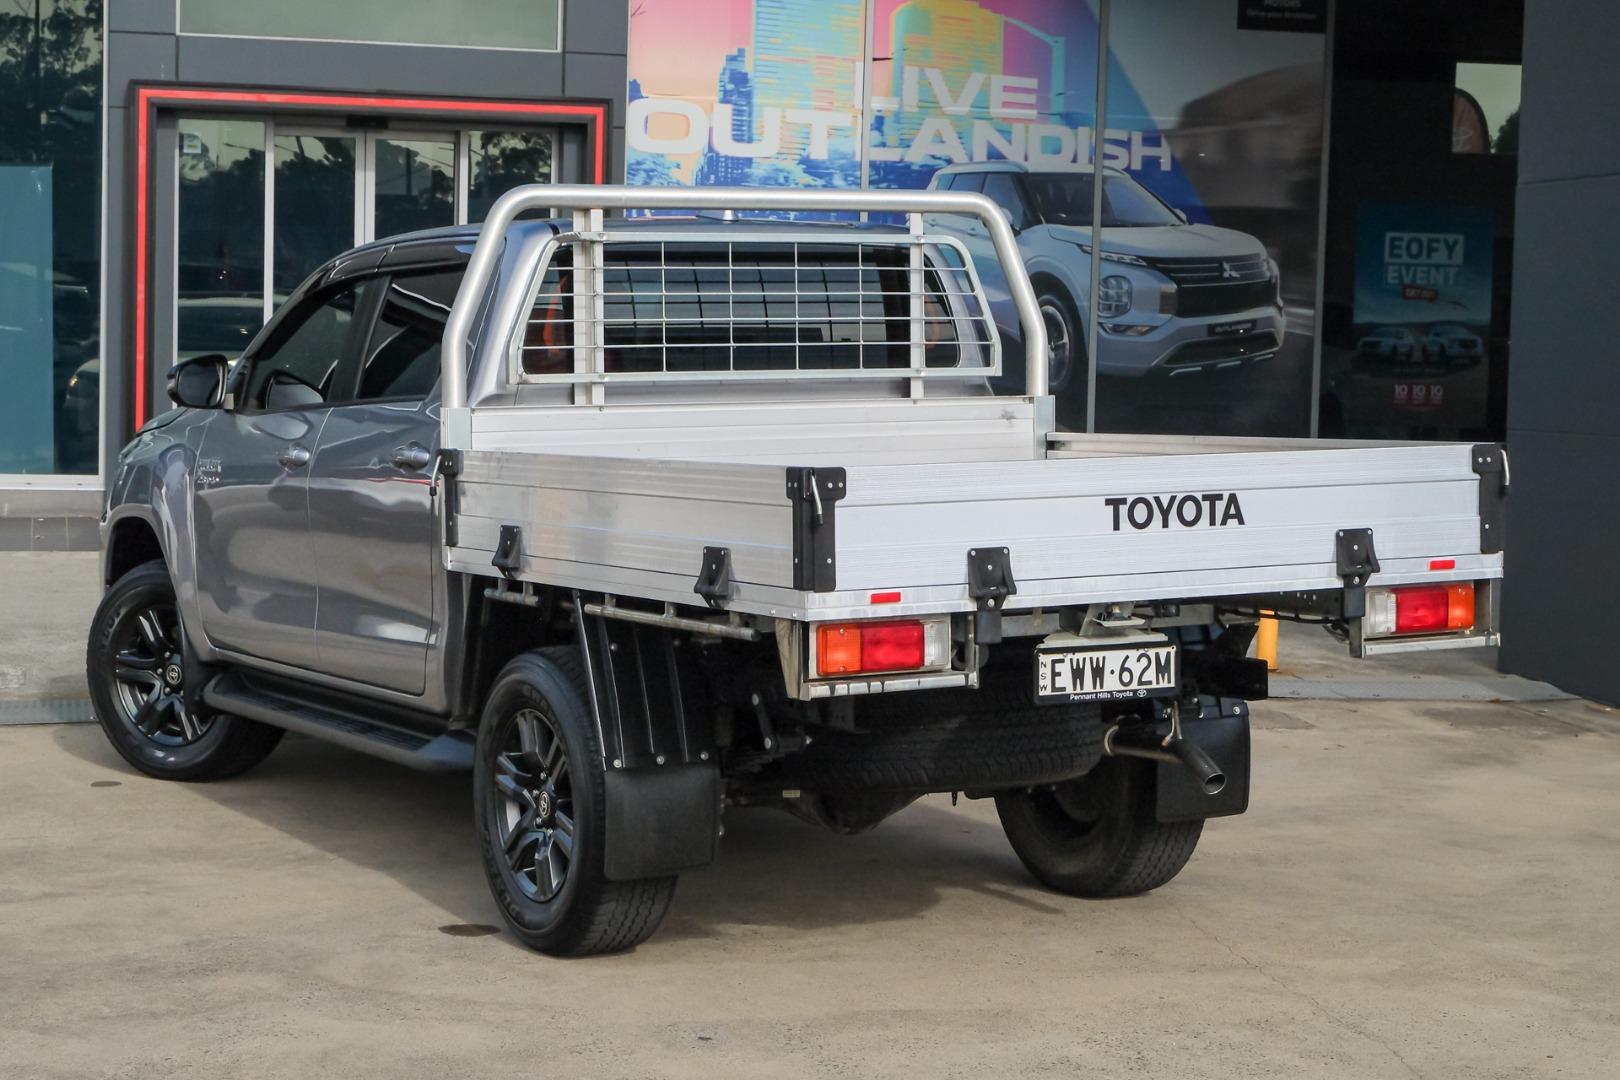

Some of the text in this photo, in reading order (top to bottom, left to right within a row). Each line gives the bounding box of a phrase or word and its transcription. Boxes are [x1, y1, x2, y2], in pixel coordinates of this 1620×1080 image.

[855, 62, 1038, 120] LIVE
[628, 98, 1172, 172] OUTLANDISH
[1389, 237, 1459, 260] EOFY
[1388, 265, 1459, 285] EVENT
[1104, 493, 1245, 531] TOYOTA
[1070, 690, 1133, 701] Pennant Hills Toyota
